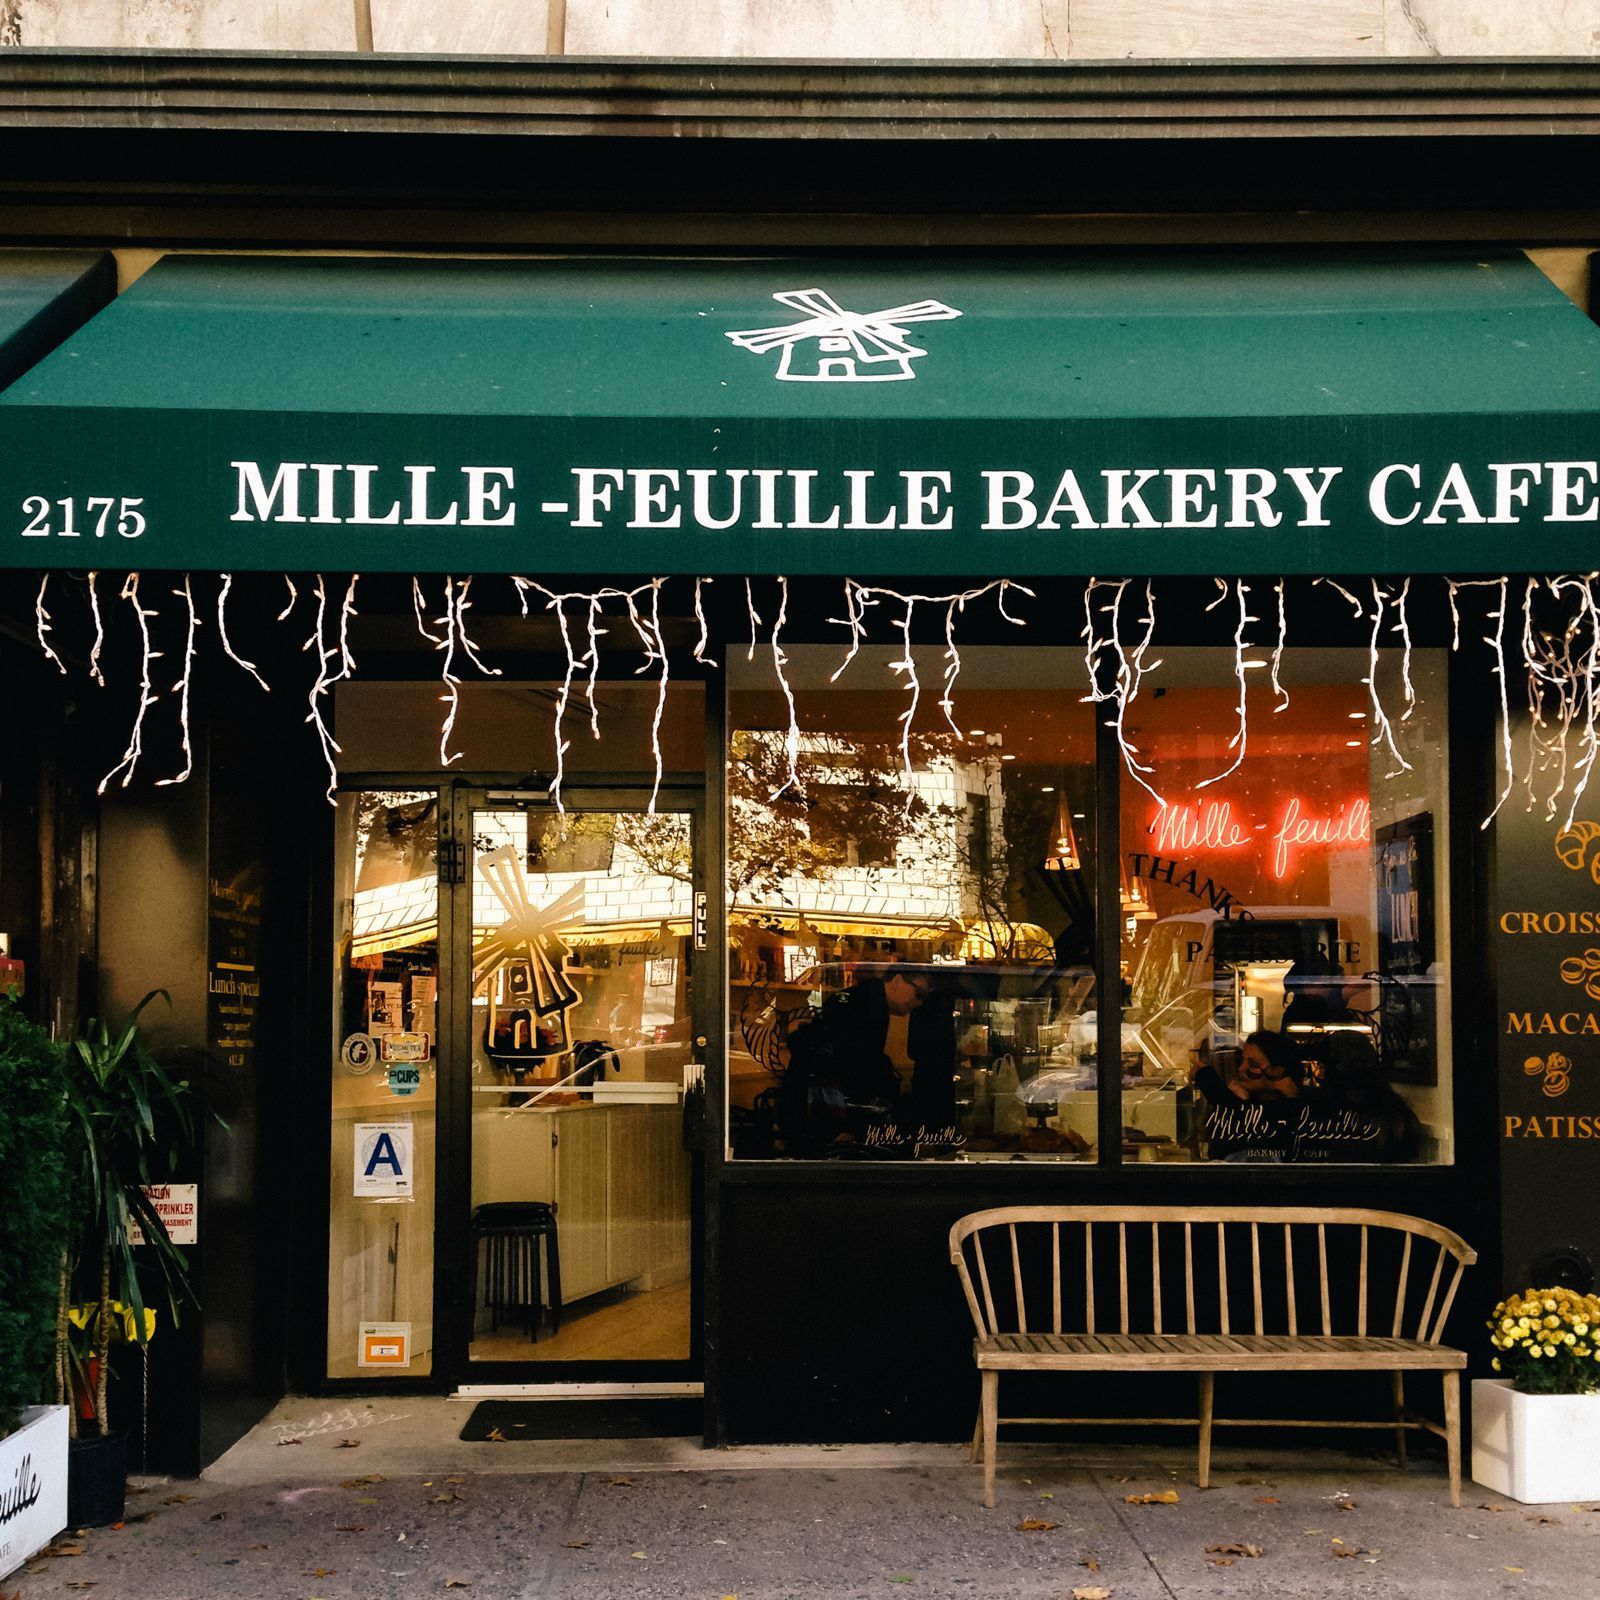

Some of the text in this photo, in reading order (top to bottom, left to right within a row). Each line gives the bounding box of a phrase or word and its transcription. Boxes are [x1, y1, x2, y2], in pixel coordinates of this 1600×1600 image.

[21, 495, 146, 538] 2175
[229, 461, 516, 526] MILLE
[980, 466, 1343, 530] BAKERY
[1367, 461, 1600, 526] CAFE
[697, 894, 707, 948] PULL
[209, 971, 236, 994] Lunch
[364, 1133, 403, 1175] A
[1247, 1149, 1287, 1158] BAKERY
[155, 1204, 193, 1215] SPRINKLER
